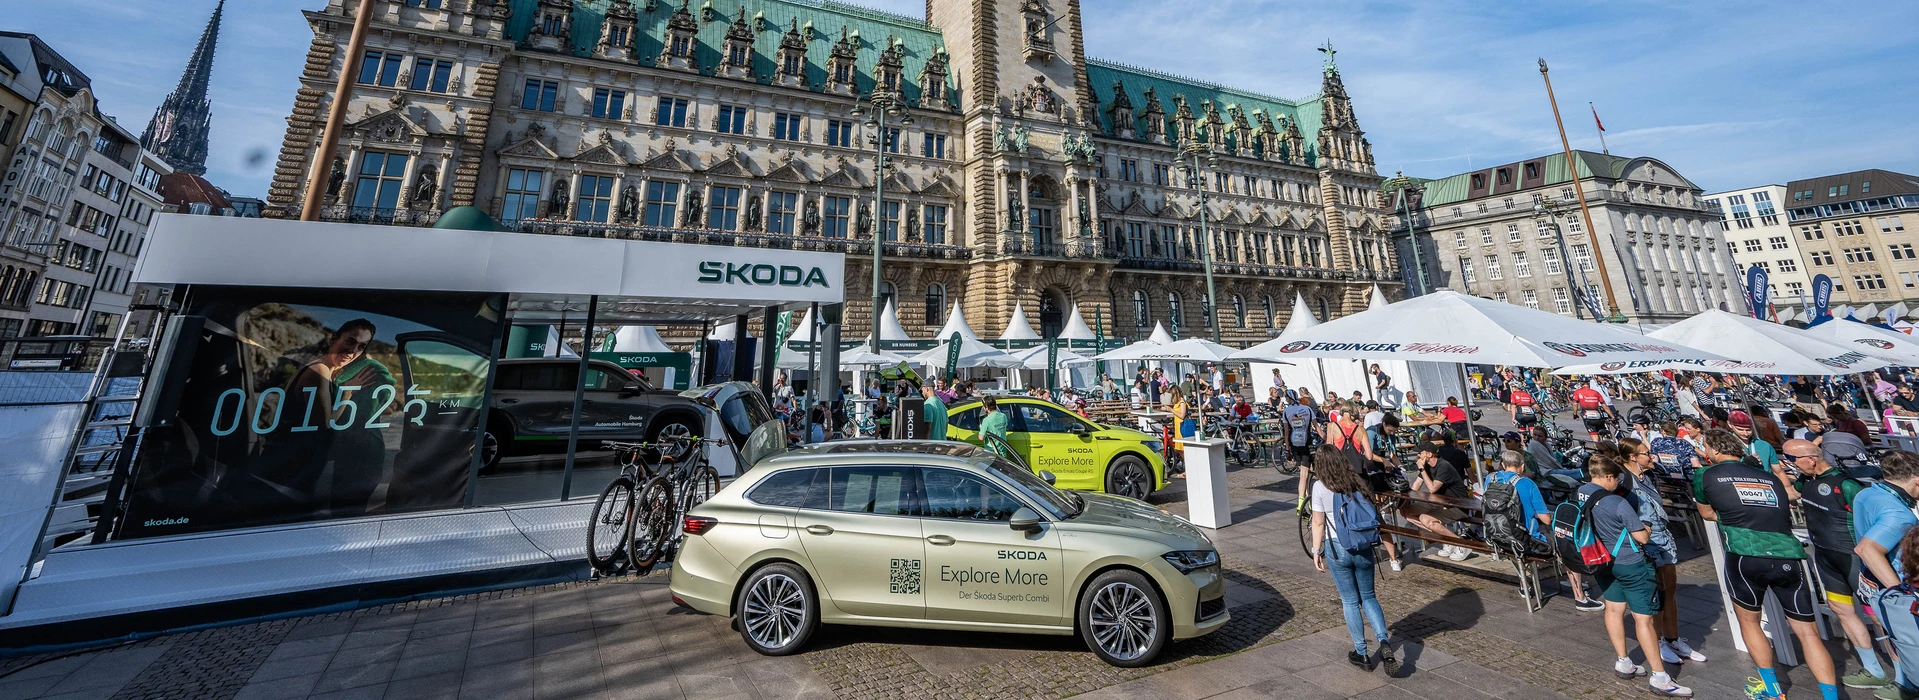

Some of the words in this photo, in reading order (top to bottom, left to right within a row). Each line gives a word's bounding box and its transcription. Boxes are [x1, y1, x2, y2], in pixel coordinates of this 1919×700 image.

[0, 147, 27, 207] APOTH
[1755, 276, 1763, 301] ABUS
[1819, 283, 1827, 305] ABUS
[1310, 342, 1401, 353] ERDINGER
[1038, 456, 1070, 467] Explore
[1071, 457, 1094, 466] More
[144, 516, 189, 527] skoda.de
[941, 565, 1000, 586] Explore
[1005, 567, 1048, 586] More
[959, 590, 973, 600] Der
[974, 589, 996, 600] Škoda
[997, 592, 1024, 603] Superb
[1025, 593, 1050, 603] Combi
